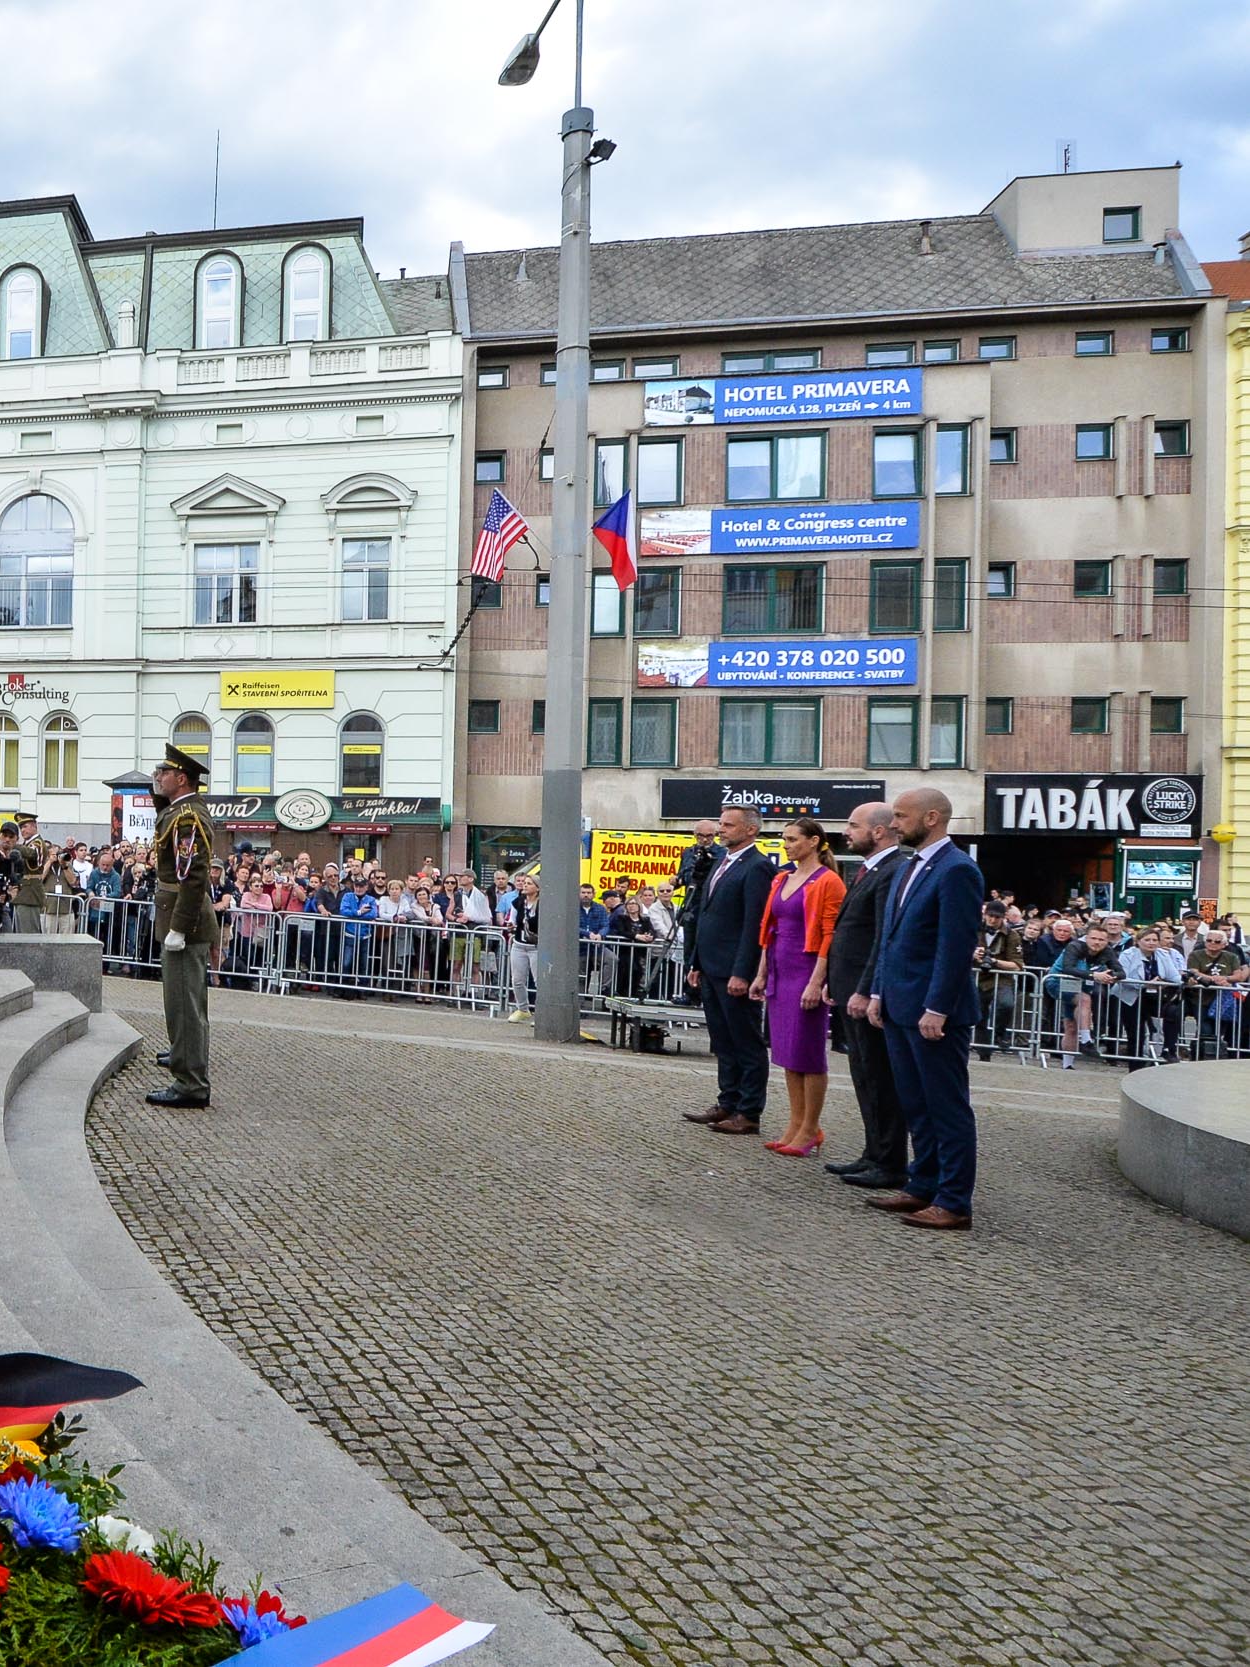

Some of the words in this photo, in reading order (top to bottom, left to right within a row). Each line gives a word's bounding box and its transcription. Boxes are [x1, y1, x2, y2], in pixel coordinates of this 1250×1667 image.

[724, 385, 787, 402] HOTEL
[792, 378, 911, 399] PRIMAVERA
[724, 403, 796, 418] NEPOMUCKÁ
[799, 403, 824, 415] 128,
[825, 400, 861, 413] PLZEŇ
[882, 401, 891, 410] 4
[892, 400, 911, 410] km
[721, 519, 762, 533] Hotel
[766, 518, 780, 531] &
[784, 516, 854, 535] Congress
[858, 515, 907, 528] centre
[735, 533, 893, 548] WWW.PRIMAVERAHOTEL.CZ
[717, 650, 770, 667] +420
[776, 649, 815, 666] 378
[820, 649, 859, 666] 020
[865, 648, 905, 665] 500
[717, 668, 778, 681] UBYTOVÁNÍ
[787, 669, 855, 681] KONFERENCE
[864, 669, 905, 679] SVATBY
[1, 687, 70, 706] Consulting
[280, 689, 328, 697] SPOŘITELNA
[721, 785, 774, 805] Žabka
[775, 796, 820, 807] Potraviny
[996, 779, 1135, 831] TABÁK
[1153, 800, 1187, 810] STRIKE
[1155, 791, 1186, 801] LUCKY
[206, 796, 262, 818] nová
[600, 856, 677, 876] ZÁCHRANNÁ
[599, 876, 647, 891] SLBA
